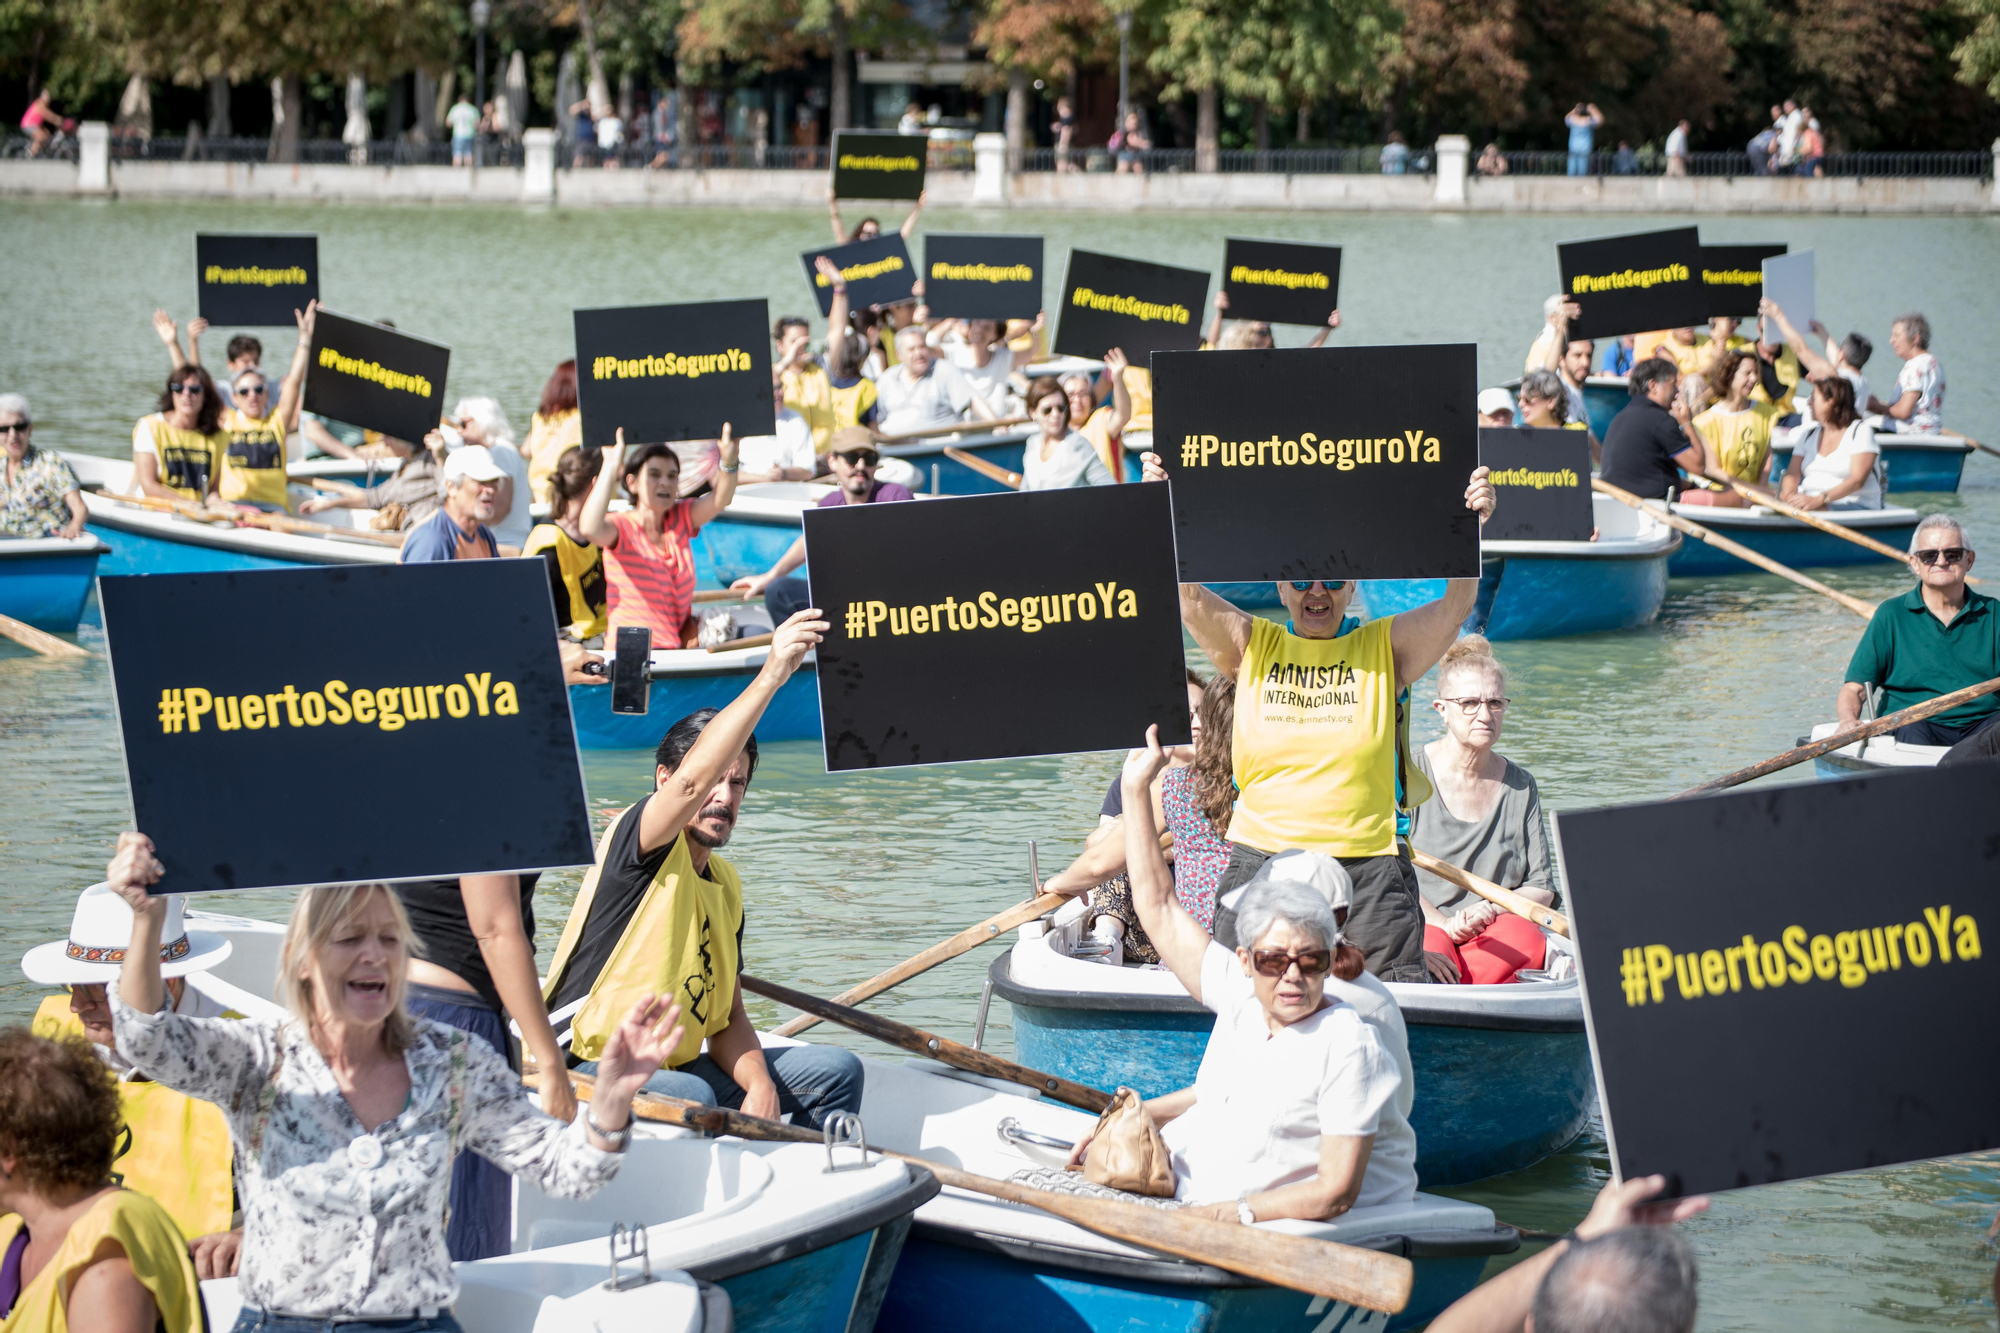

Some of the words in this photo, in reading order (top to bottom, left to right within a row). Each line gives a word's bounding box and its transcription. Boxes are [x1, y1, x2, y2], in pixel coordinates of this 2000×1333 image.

[205, 265, 307, 287] #PuertoSeguroYa
[1571, 262, 1690, 295] #PuertoSeguroYa
[1072, 287, 1190, 325] #PuertoSeguroYa
[318, 347, 432, 398] #PuertoSeguroYa
[593, 347, 752, 381] #PuertoSeguroYa
[1180, 430, 1442, 472] #PuertoSeguroYa
[1488, 467, 1579, 490] uertoSeguroYa
[844, 581, 1139, 640] #PuertoSeguroYa
[1267, 660, 1356, 689] AMNISTÍA
[157, 672, 520, 735] #PuertoSeguroYa
[1264, 690, 1358, 708] INTERNACIONAL
[1264, 714, 1353, 725] www.es.amnesty.org
[1620, 904, 1982, 1007] #PuertoSeguroYa
